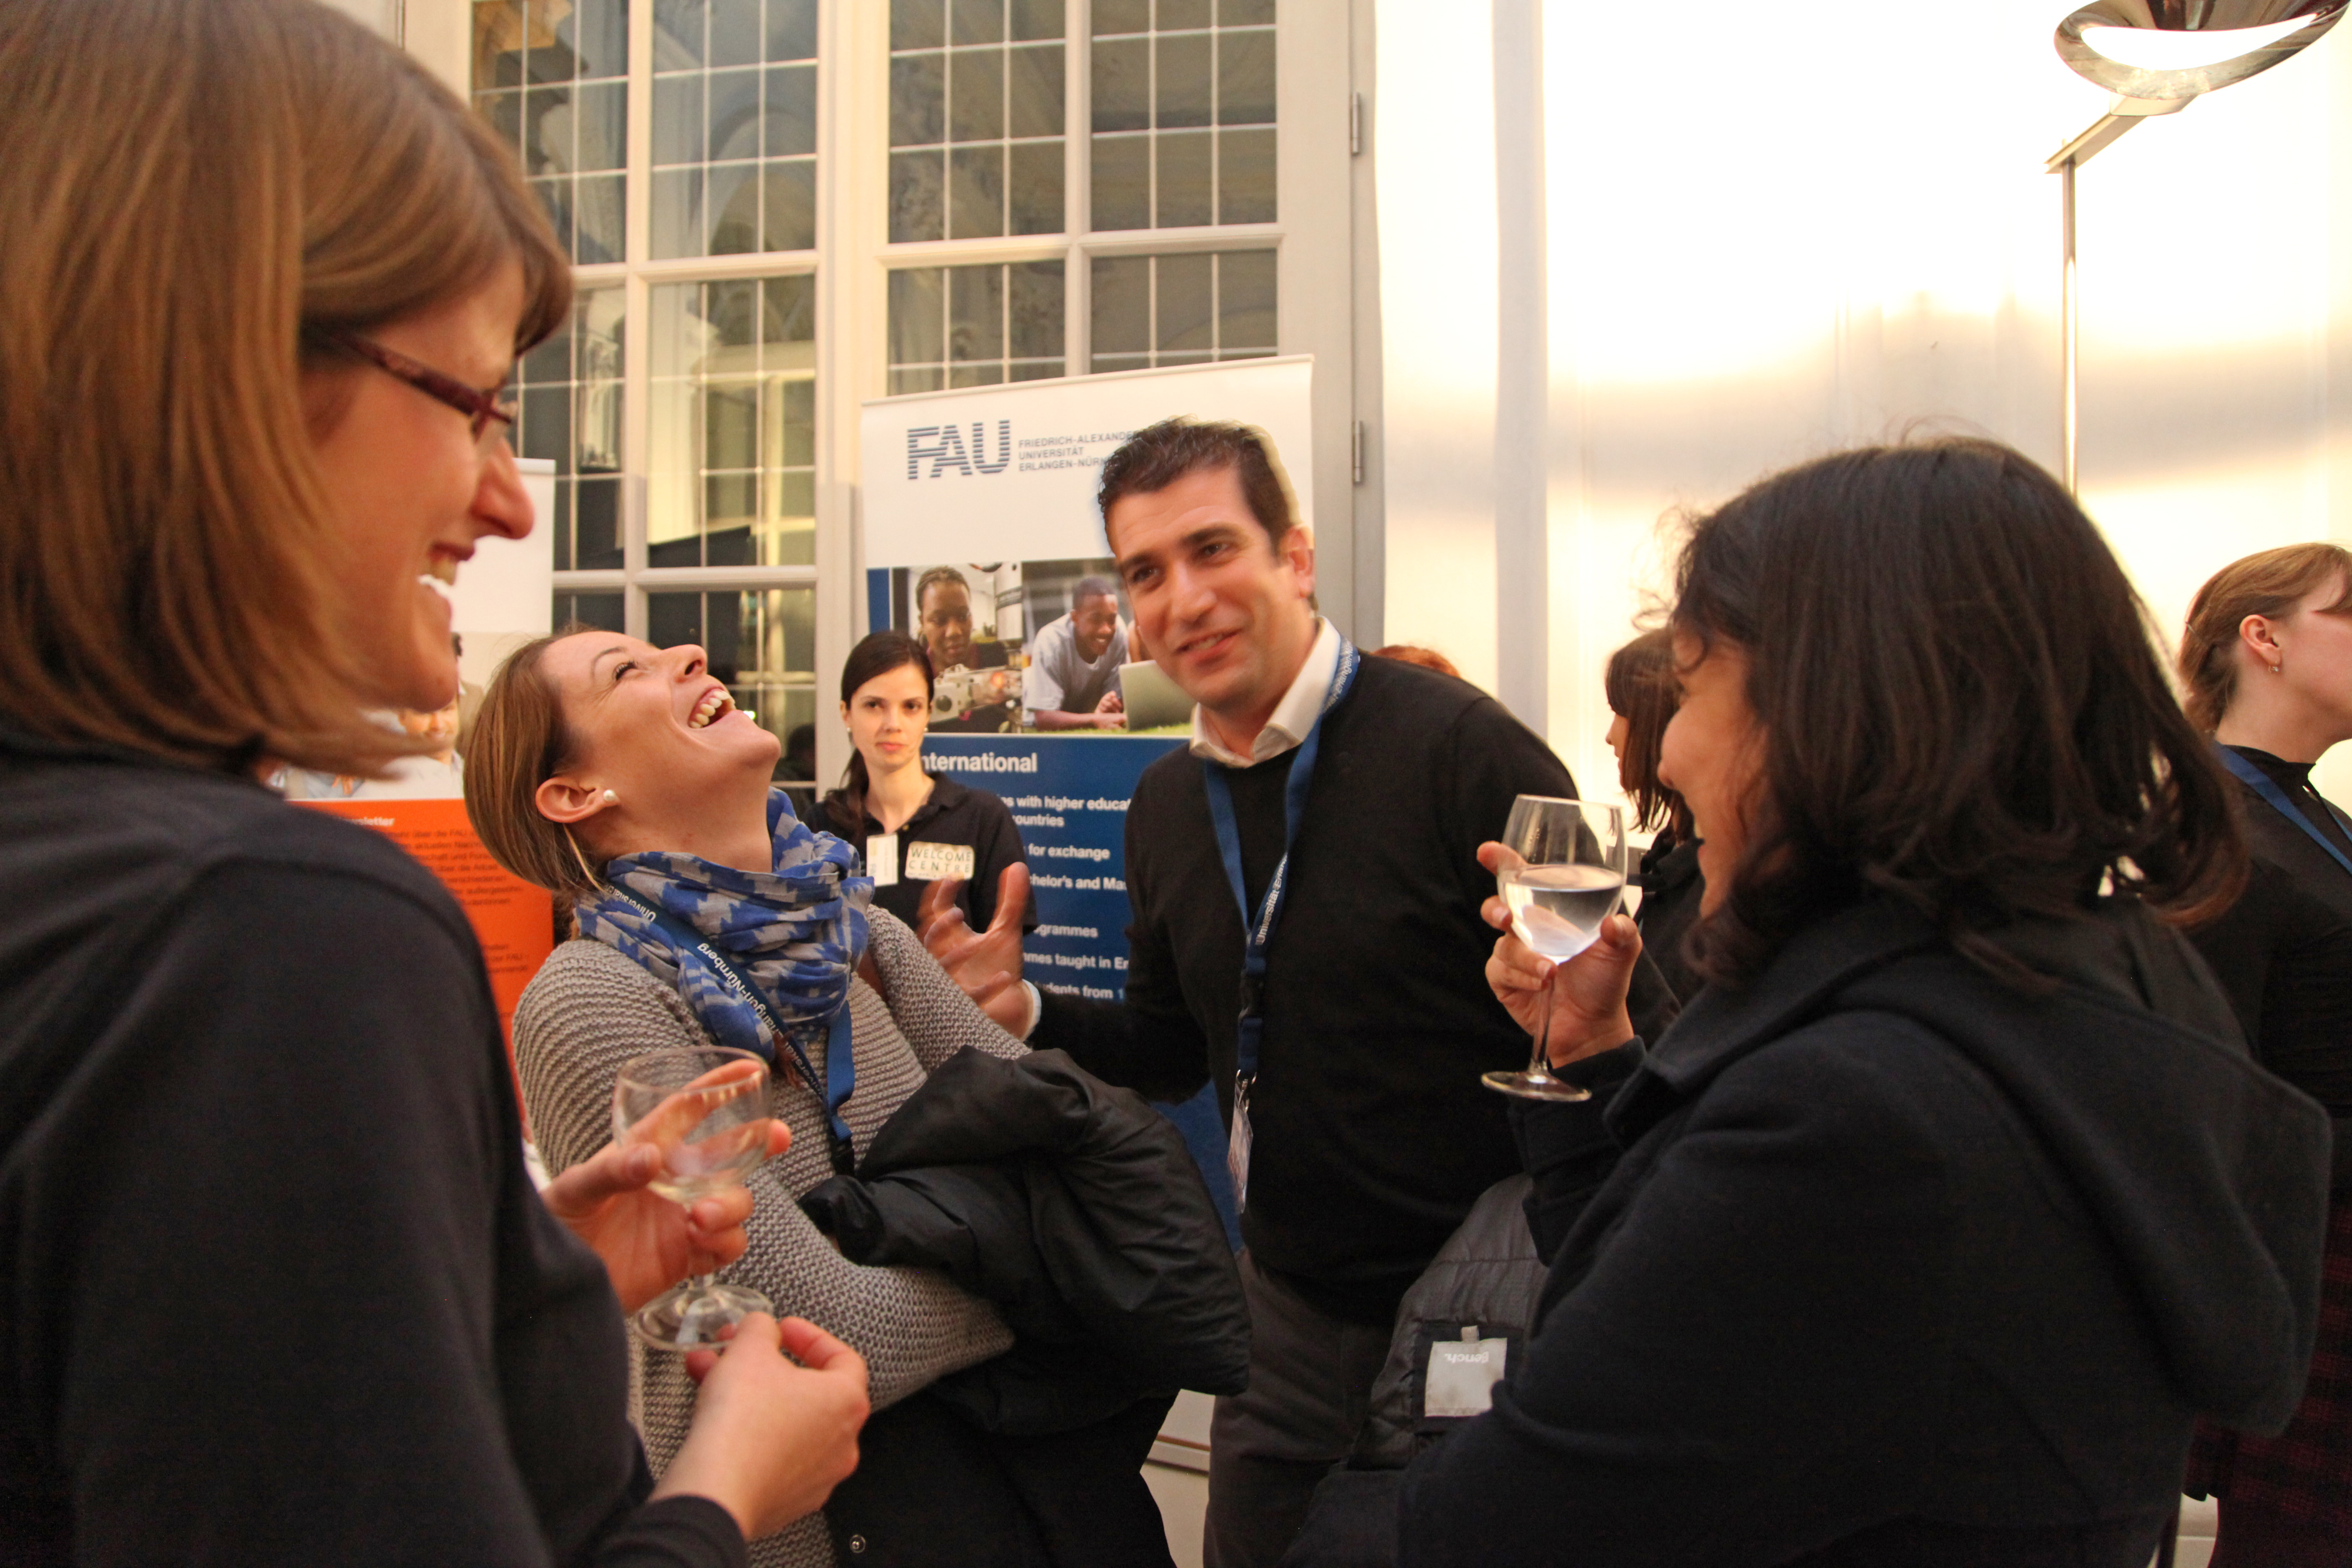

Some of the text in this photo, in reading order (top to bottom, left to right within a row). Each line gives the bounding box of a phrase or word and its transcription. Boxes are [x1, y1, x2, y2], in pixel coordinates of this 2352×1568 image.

[907, 419, 1010, 479] FAU
[1019, 446, 1083, 459] UNIVERSITÄT
[1016, 795, 1042, 807] with
[1044, 796, 1085, 812] higher
[911, 848, 972, 861] WELCOME
[1028, 843, 1110, 862] for exchange
[909, 860, 970, 873] CENTRE
[1075, 877, 1101, 890] and
[1055, 953, 1096, 970] taught
[1099, 956, 1112, 969] in
[1082, 985, 1114, 999] from
[1444, 1351, 1490, 1364] Bench.
